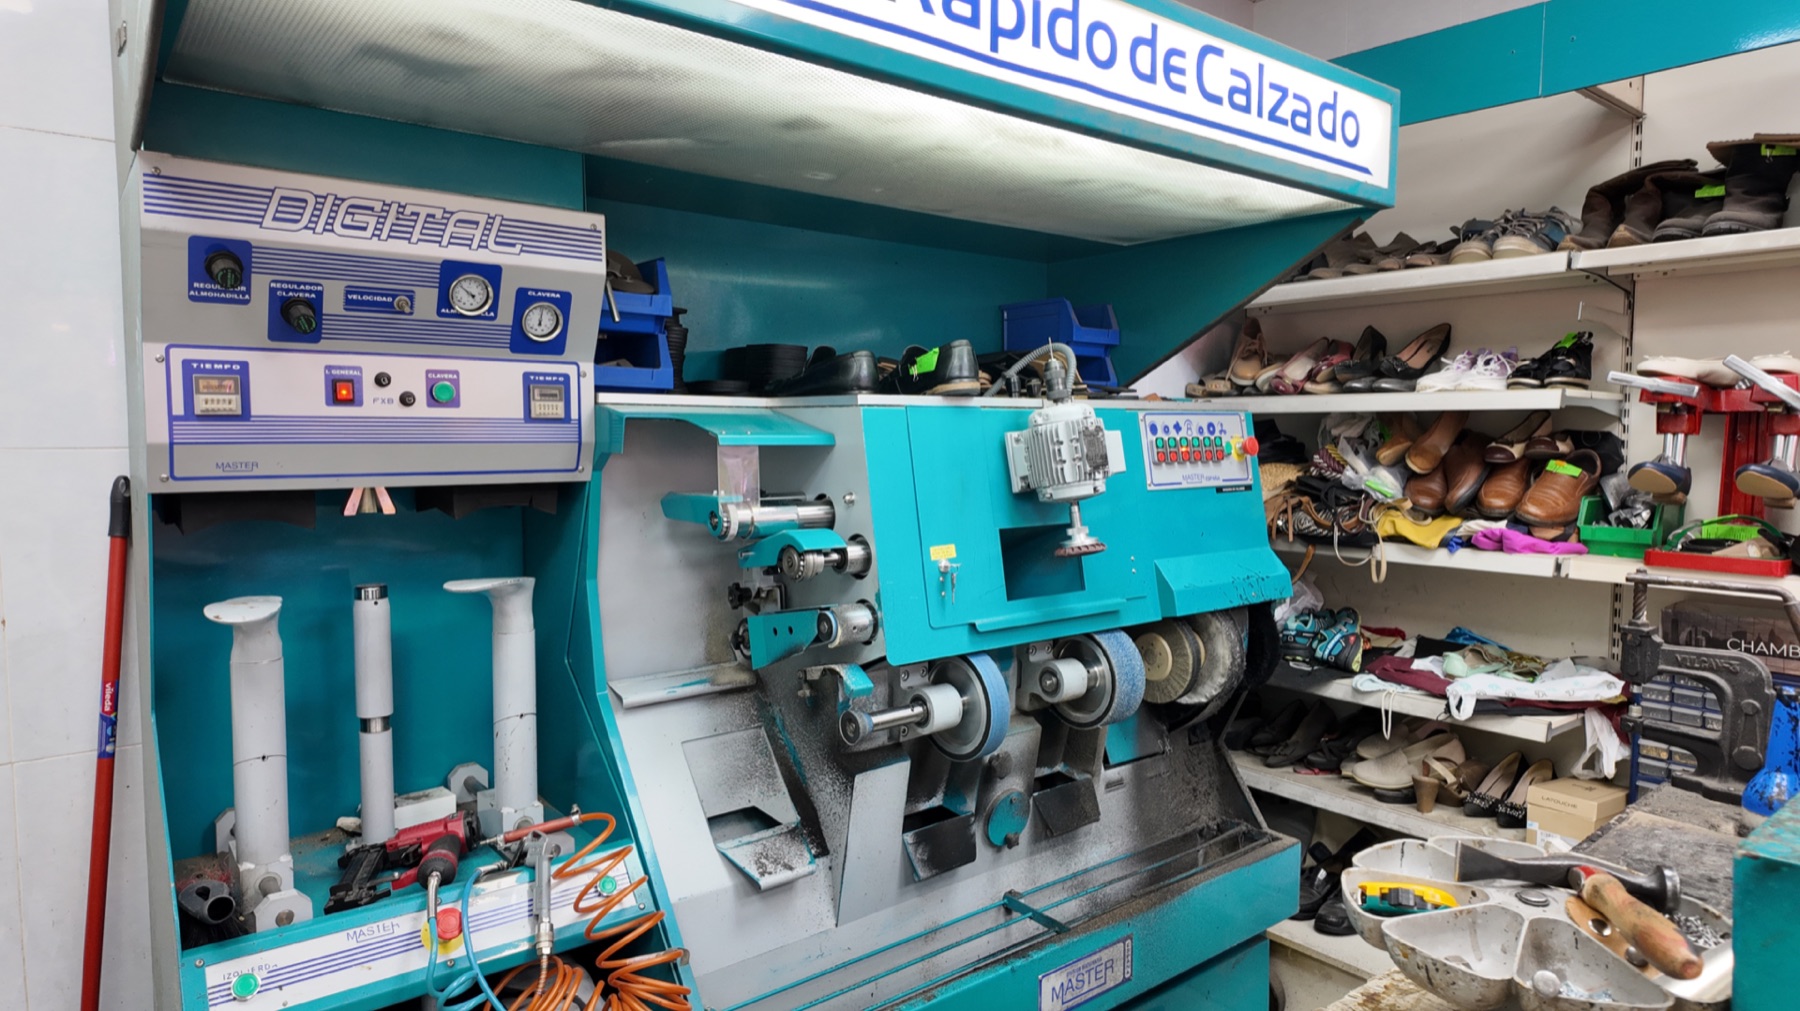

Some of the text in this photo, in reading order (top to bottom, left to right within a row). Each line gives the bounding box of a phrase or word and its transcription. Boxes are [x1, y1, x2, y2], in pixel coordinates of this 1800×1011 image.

[1129, 23, 1186, 94] de
[1196, 44, 1360, 148] Calzado
[260, 186, 523, 256] DIGITAL
[270, 282, 323, 291] REGULADOR
[189, 290, 250, 300] ALMOHADILLA
[277, 290, 316, 299] CLAVERA
[347, 294, 393, 302] VELOCIDAD
[528, 290, 561, 298] CLAVERA
[215, 461, 259, 473] MASTER
[1182, 472, 1205, 484] MASTER
[1727, 637, 1800, 658] CHAMB
[104, 682, 114, 712] vileda
[1541, 795, 1578, 809] LATOUCHE
[1051, 958, 1115, 1006] MASTER
